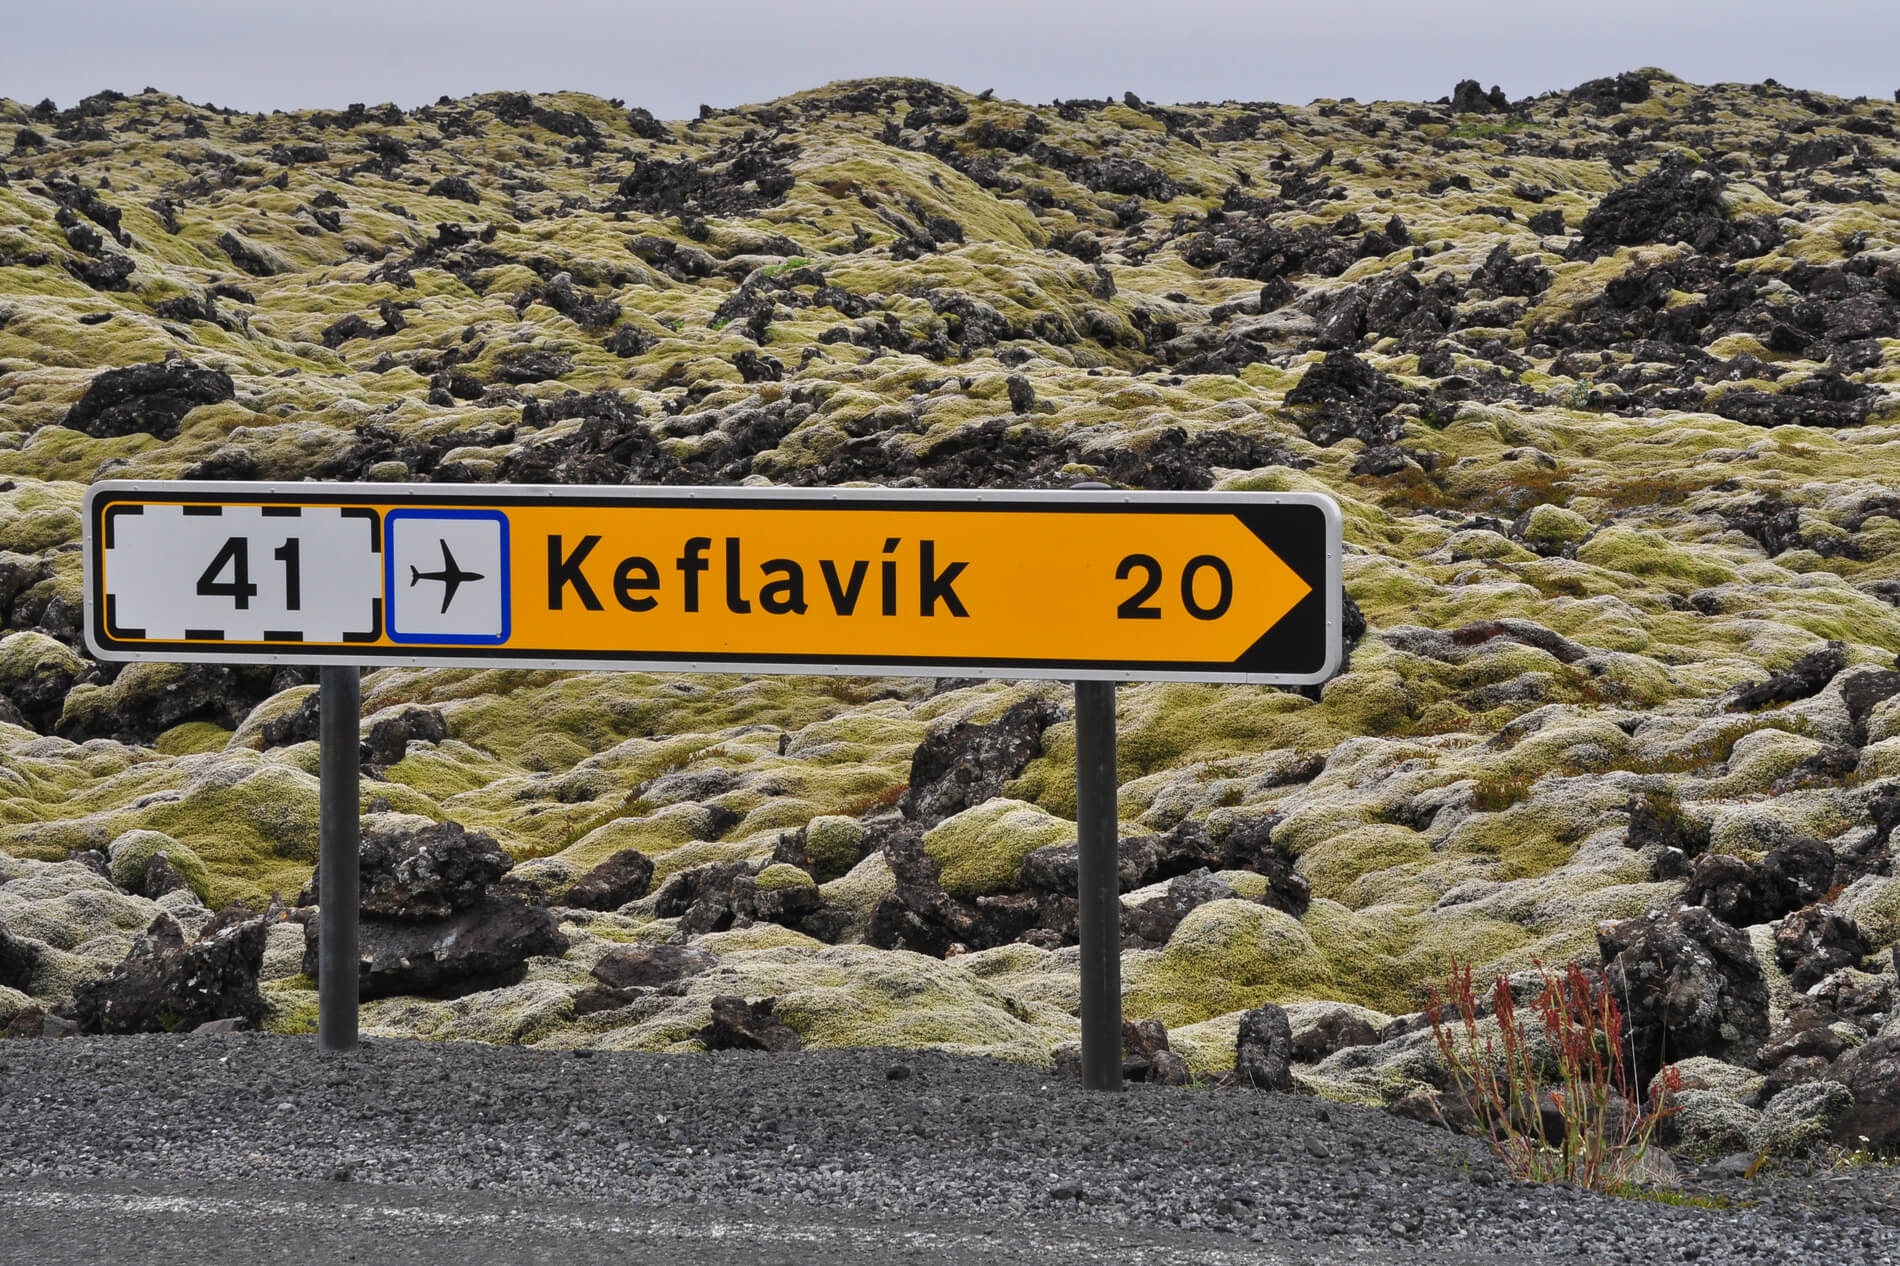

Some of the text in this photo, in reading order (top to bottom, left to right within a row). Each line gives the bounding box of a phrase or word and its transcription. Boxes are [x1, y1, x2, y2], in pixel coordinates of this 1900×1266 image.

[196, 536, 301, 612] 41
[547, 534, 1234, 621] Keflavík 20
